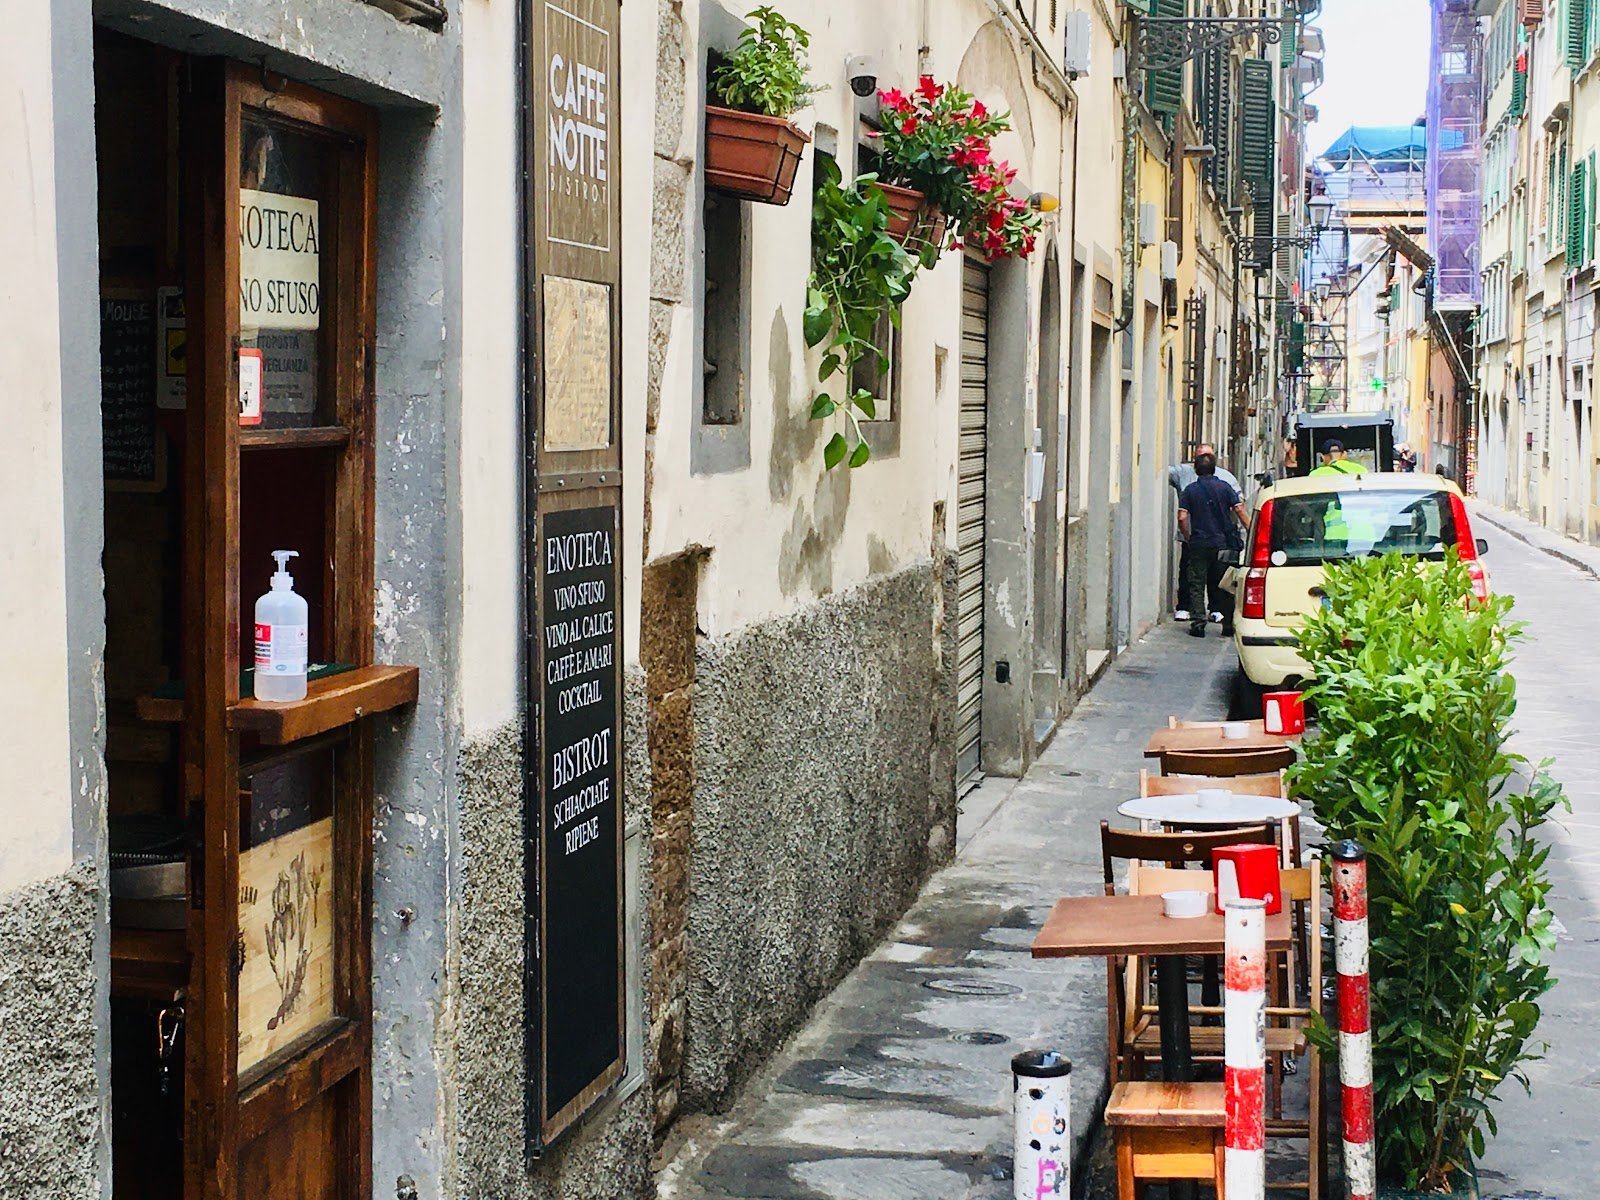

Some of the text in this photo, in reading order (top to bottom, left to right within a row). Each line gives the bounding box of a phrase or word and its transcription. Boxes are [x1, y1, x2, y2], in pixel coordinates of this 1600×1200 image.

[550, 53, 606, 125] CAFFE
[550, 113, 607, 182] NOTTE
[550, 172, 607, 204] BISTROT
[267, 279, 319, 315] SFUSO
[546, 530, 613, 575] ENOTECA
[554, 580, 606, 612] VINO SFUSO
[545, 610, 614, 649] VINO AL CALICE
[547, 643, 613, 685] CAFFÈ E AMARI
[558, 680, 602, 715] COCKTAIL
[552, 727, 611, 790] BISTROT
[553, 777, 610, 831] SCHIACCIATE
[565, 815, 599, 856] RIPIENE
